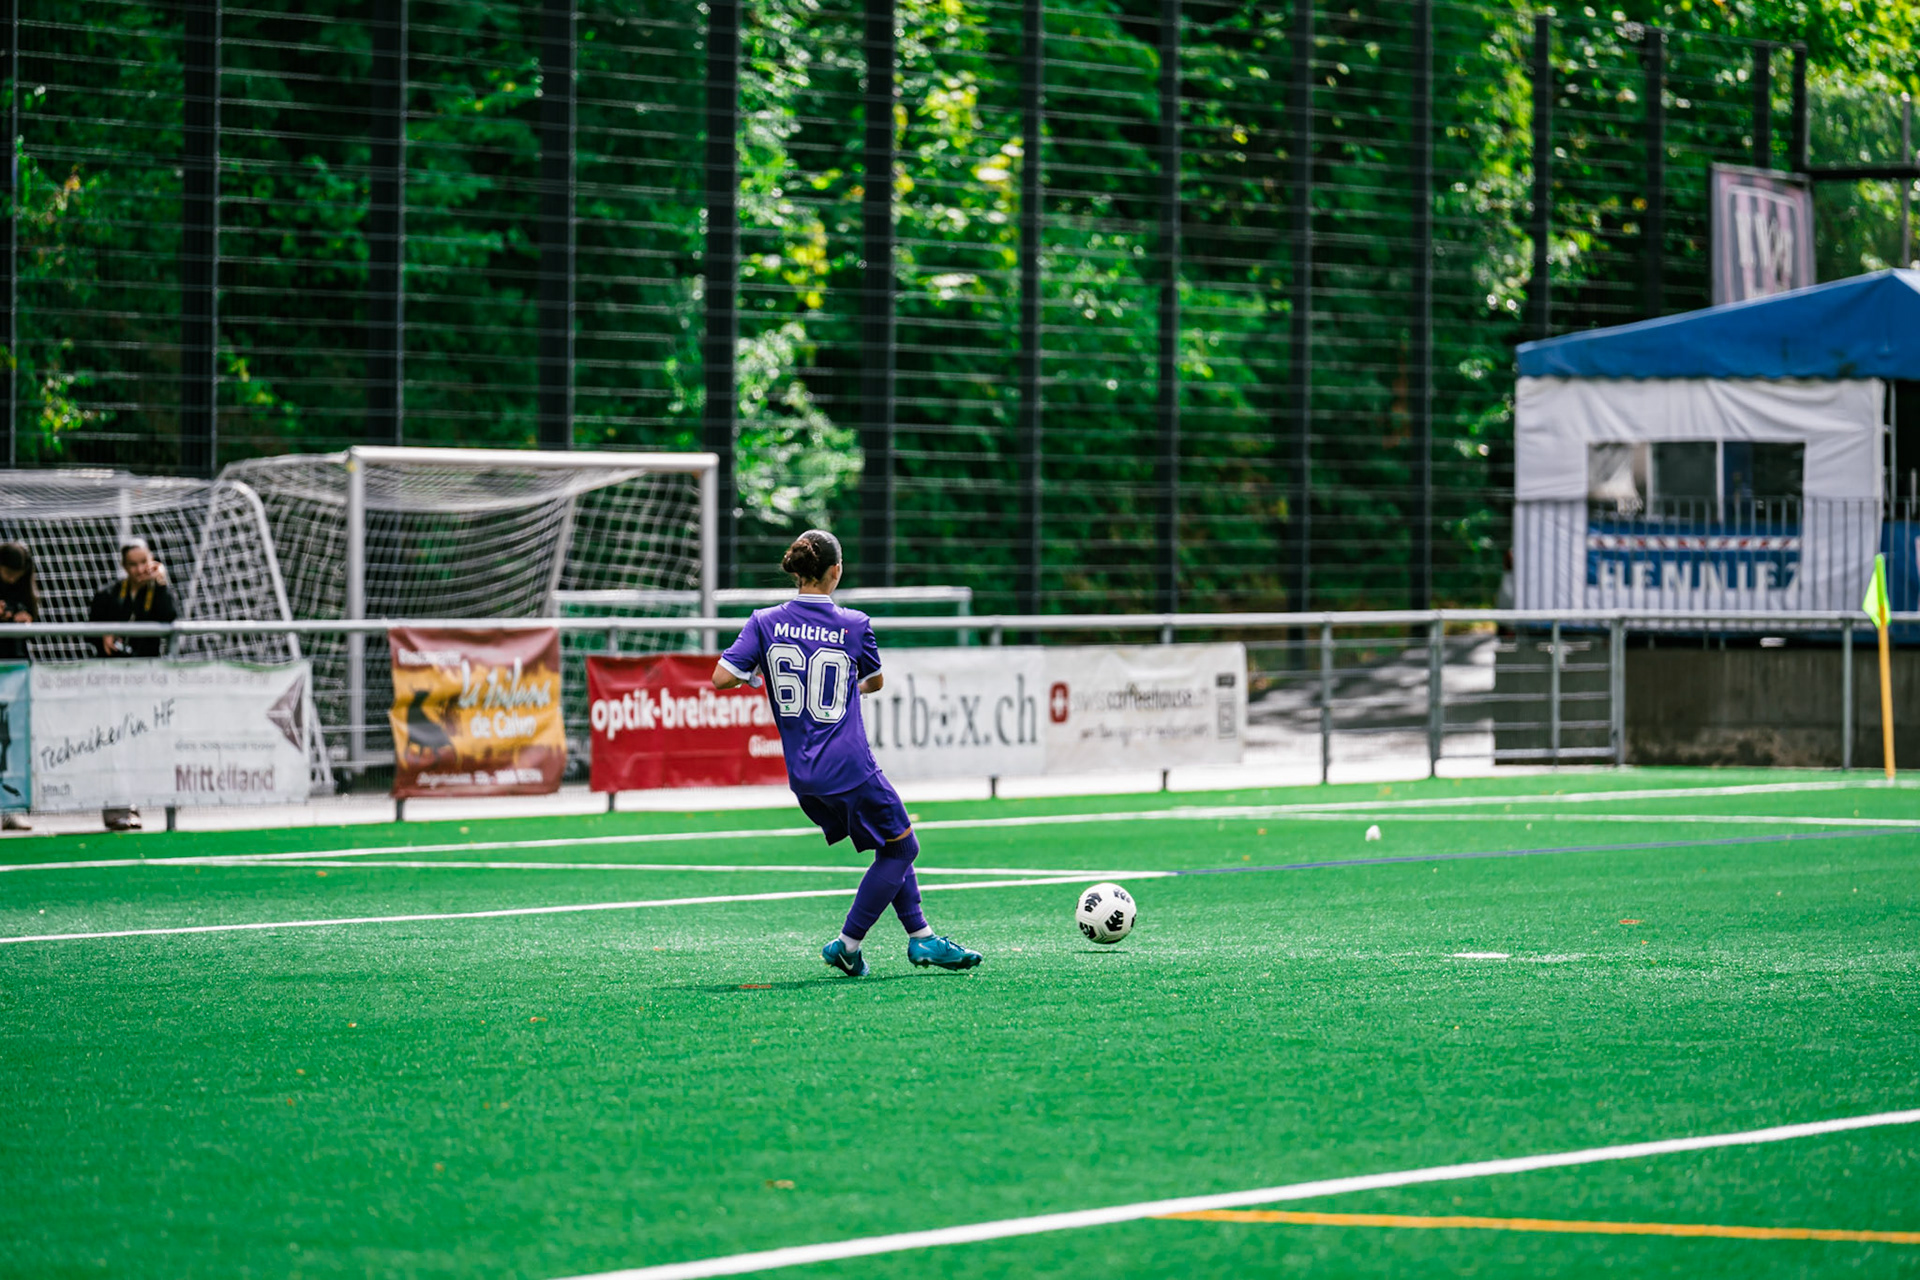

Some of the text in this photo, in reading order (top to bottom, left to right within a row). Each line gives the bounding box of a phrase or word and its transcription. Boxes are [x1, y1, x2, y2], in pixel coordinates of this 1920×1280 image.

[773, 622, 846, 645] Multitel
[766, 643, 851, 724] 60
[153, 698, 175, 728] HF
[175, 763, 276, 793] Mittelland
